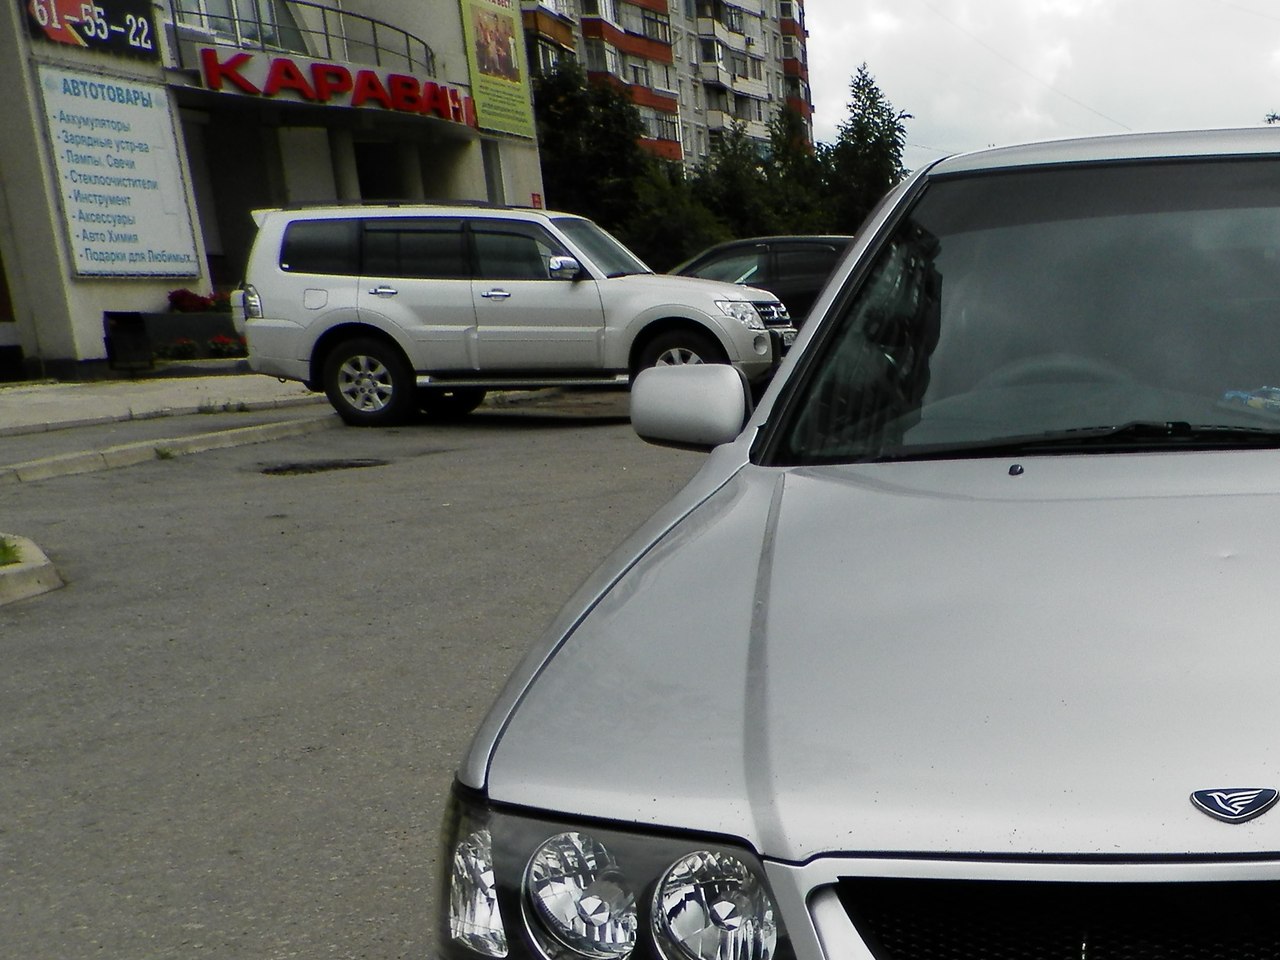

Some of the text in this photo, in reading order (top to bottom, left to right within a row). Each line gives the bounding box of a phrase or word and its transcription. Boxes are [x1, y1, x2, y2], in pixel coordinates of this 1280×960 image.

[62, 78, 153, 108] АВТОТОВАРЫ
[60, 110, 131, 132] Аккумуляторы
[62, 130, 113, 148] Зарядные
[106, 154, 136, 169] Свечи
[70, 169, 158, 190] Стеклоочистители
[73, 189, 131, 208] Инструмент
[78, 209, 136, 227] Аксессуары
[82, 228, 139, 243] Авто Химия
[85, 247, 126, 264] Подарки
[129, 251, 146, 263] для
